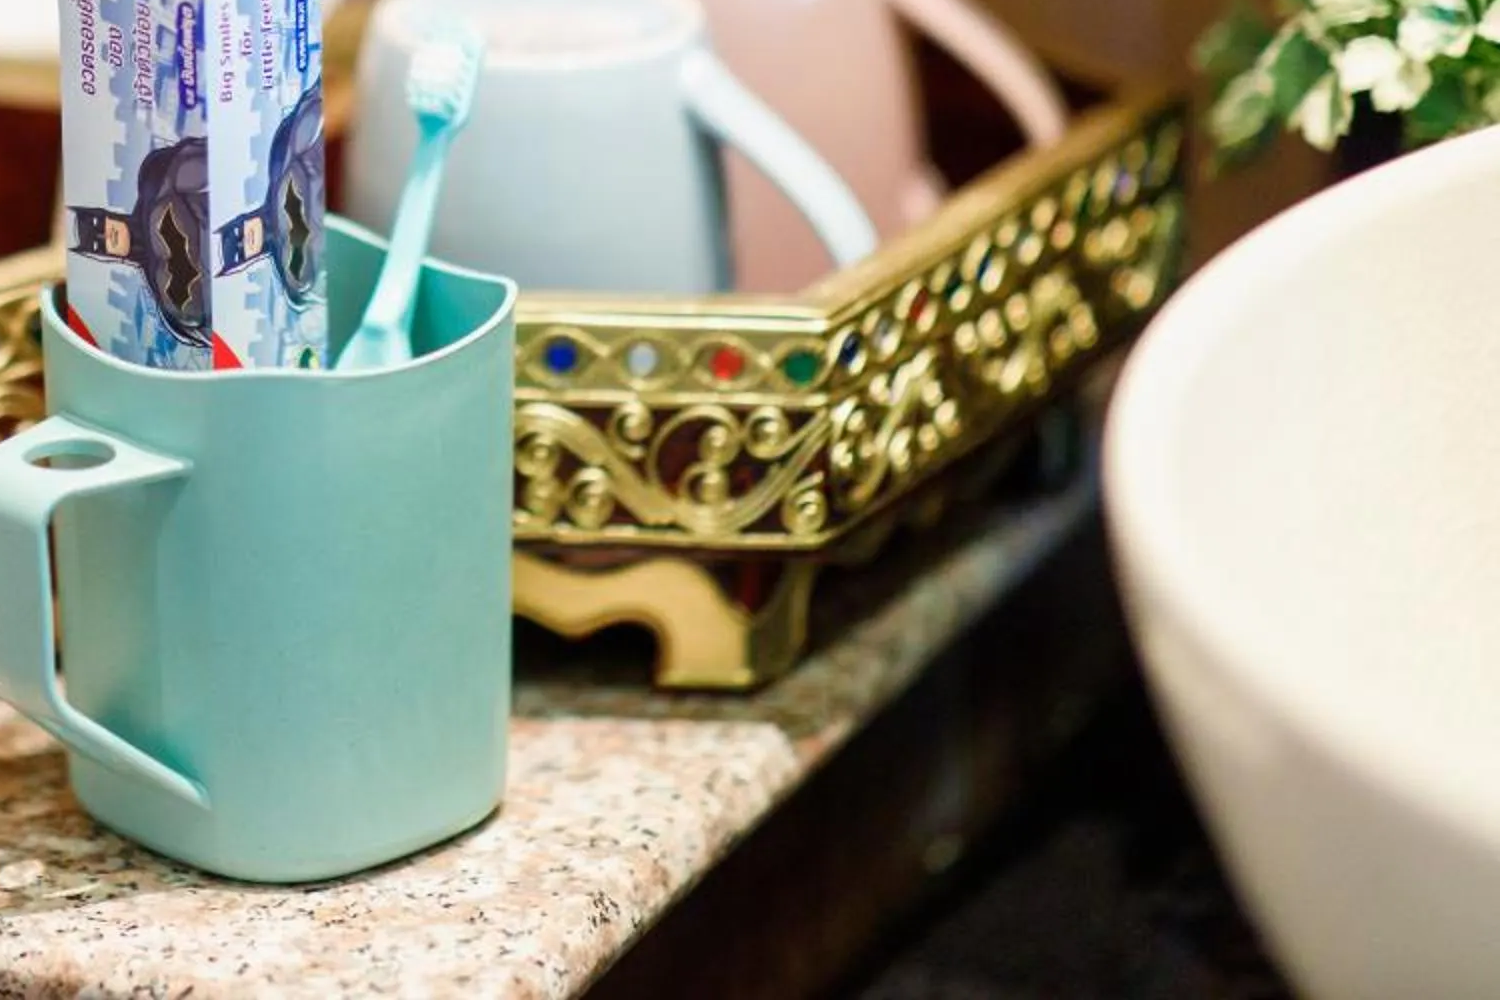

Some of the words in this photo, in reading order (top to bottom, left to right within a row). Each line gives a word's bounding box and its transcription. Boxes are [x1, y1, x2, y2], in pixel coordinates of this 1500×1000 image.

[109, 24, 124, 68] ของ
[219, 2, 232, 67] Smiles
[240, 30, 254, 58] for
[221, 70, 234, 103] Big
[261, 38, 275, 91] Little
